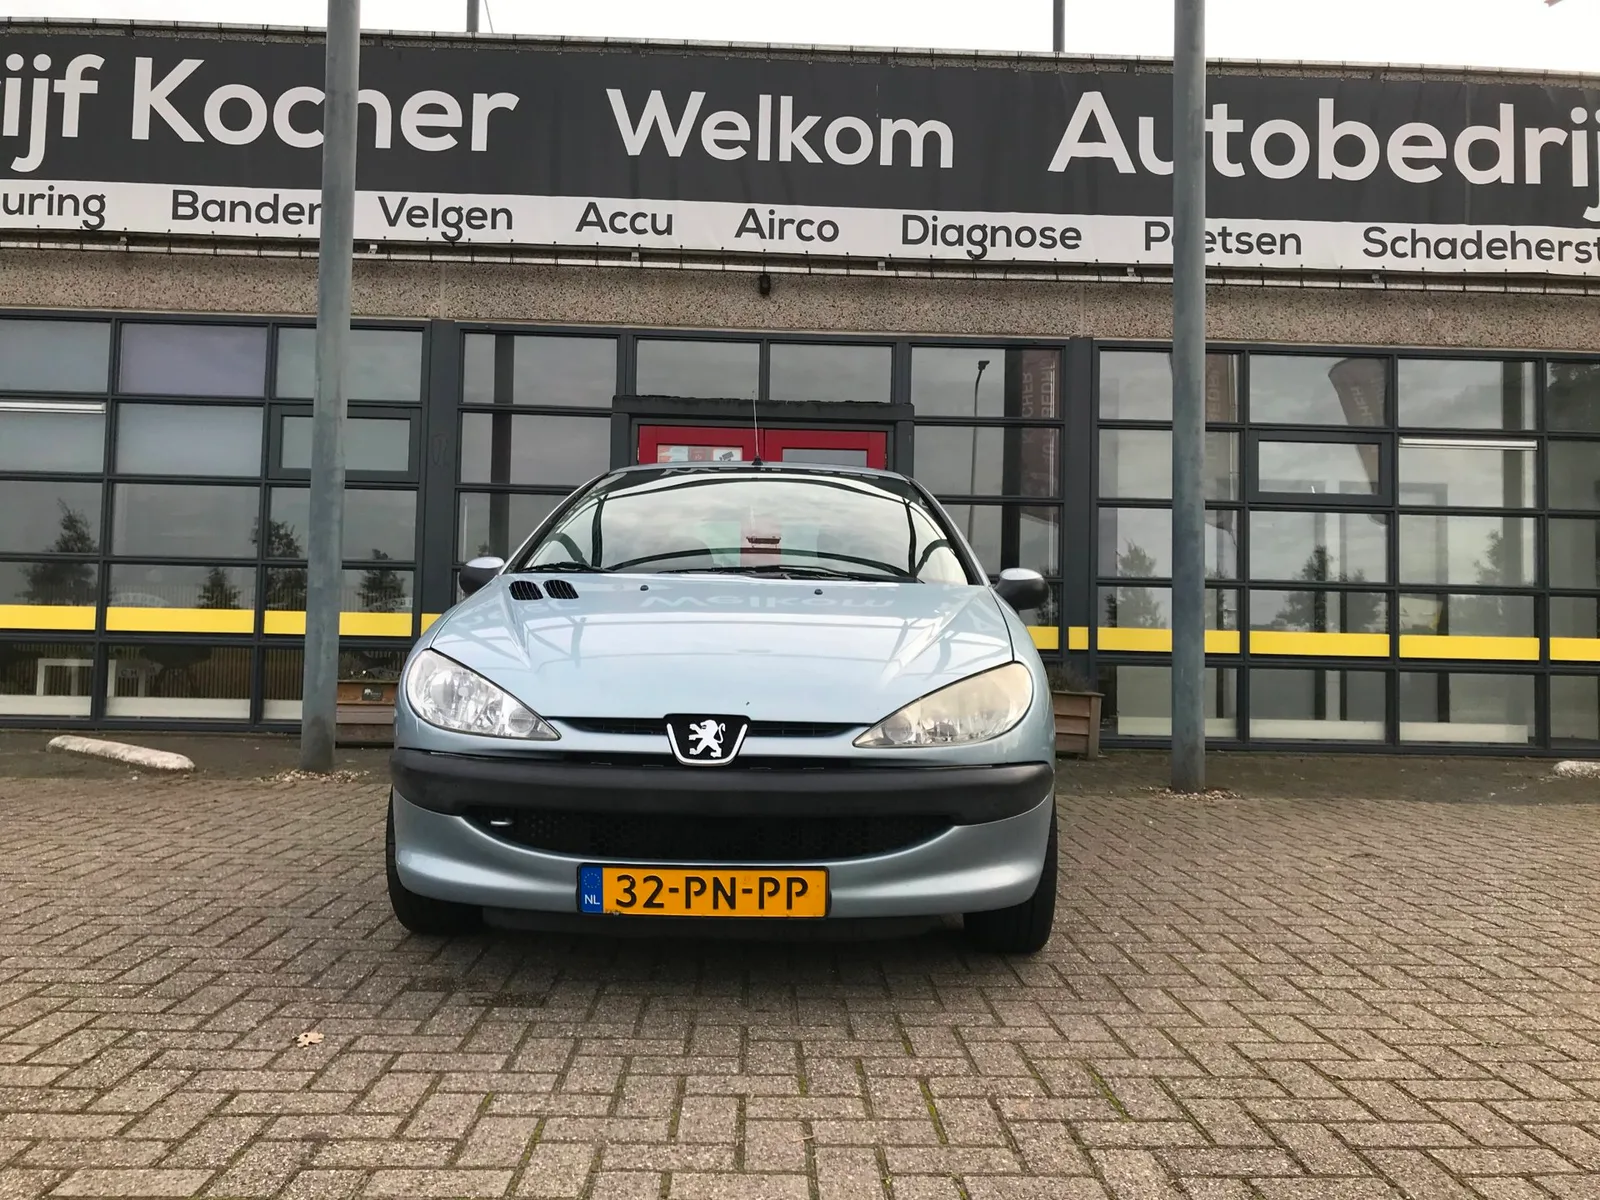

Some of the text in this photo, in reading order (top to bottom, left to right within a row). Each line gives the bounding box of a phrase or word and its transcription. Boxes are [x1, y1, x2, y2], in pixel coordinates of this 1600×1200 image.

[0, 54, 105, 173] ijf
[606, 89, 953, 169] Welkom
[1048, 91, 1600, 222] Autobedri
[3, 185, 106, 231] uring
[378, 197, 513, 242] Velgen
[576, 202, 673, 236] Accu
[735, 208, 840, 243] Airco
[902, 215, 1082, 260] Diagnose
[1145, 221, 1302, 256] Petsen
[584, 894, 600, 905] NL
[615, 874, 809, 910] 32-PN-PP
